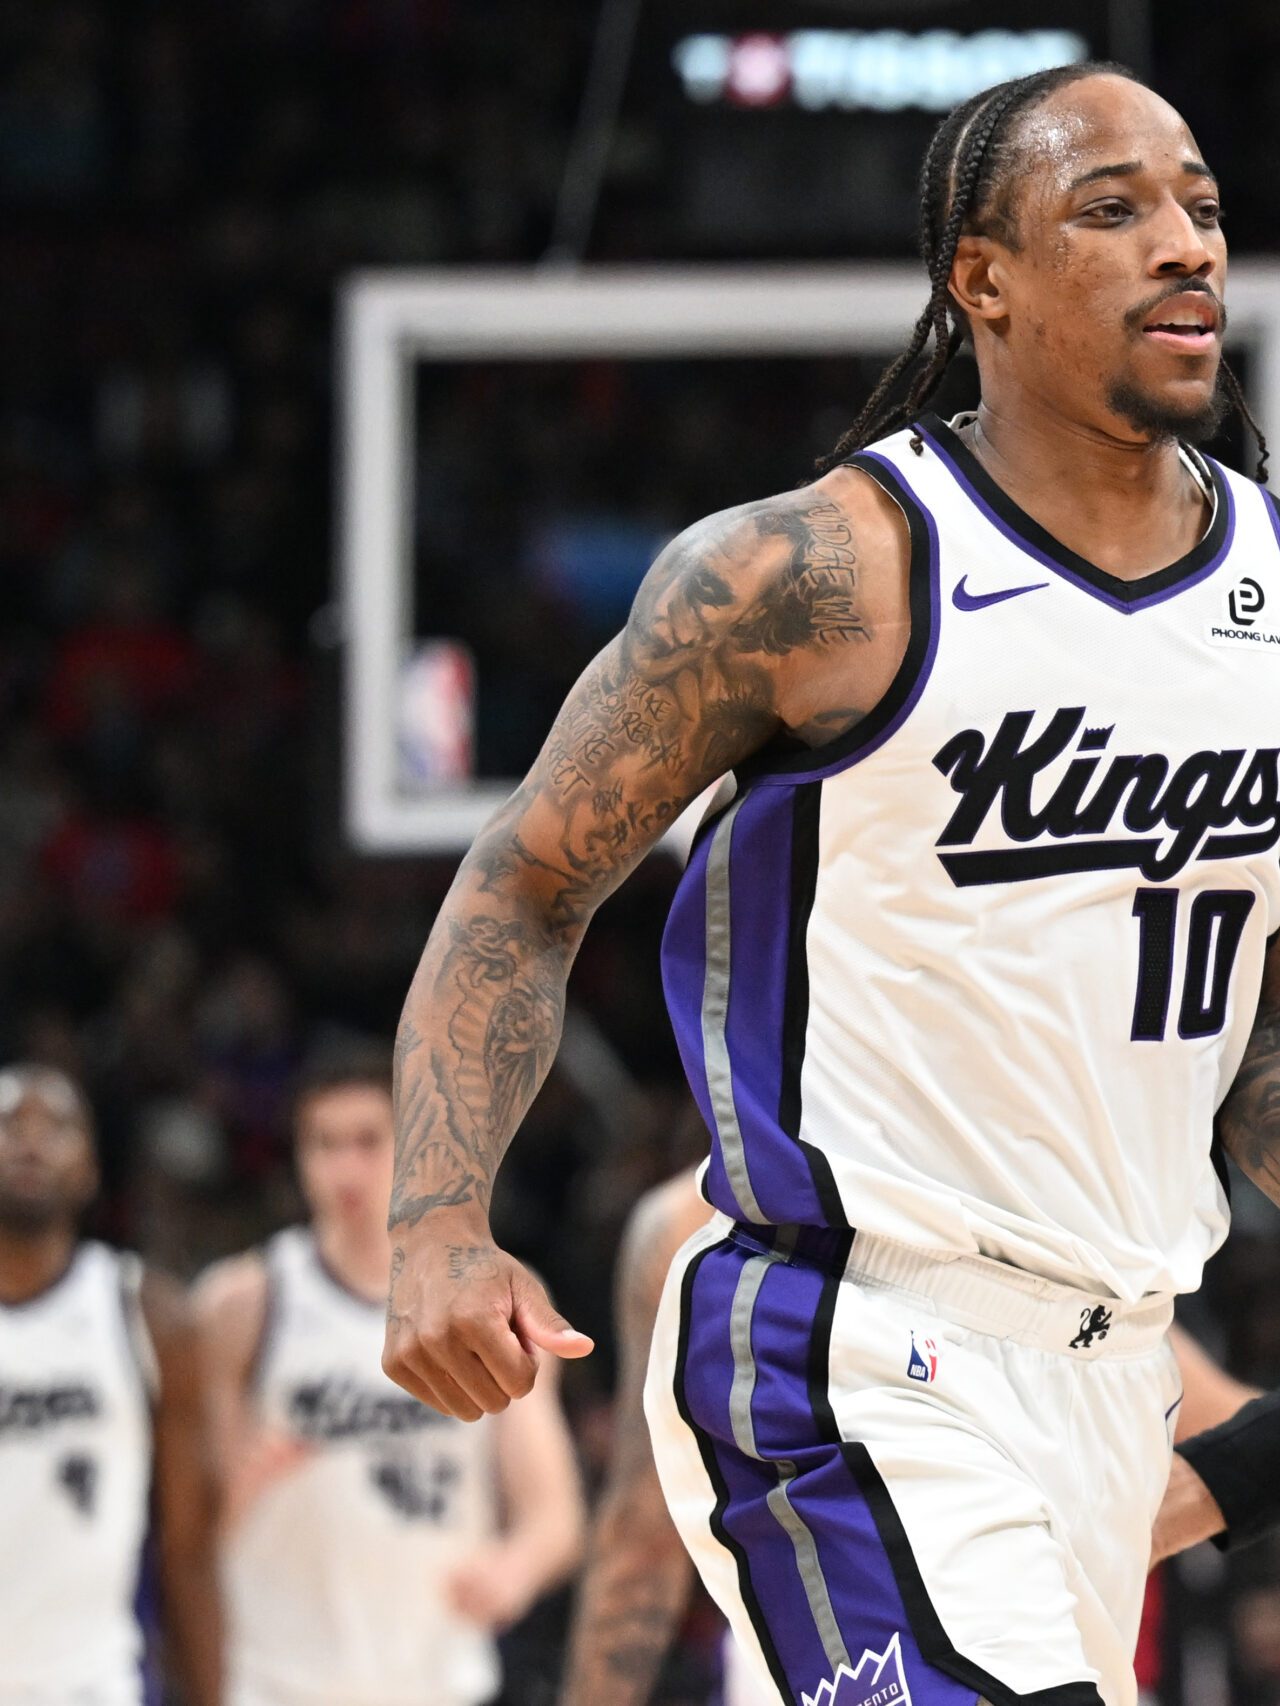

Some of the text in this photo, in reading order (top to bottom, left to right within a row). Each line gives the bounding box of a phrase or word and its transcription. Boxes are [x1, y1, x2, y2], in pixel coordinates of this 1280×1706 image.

[1211, 626, 1261, 642] PHOONG
[1130, 886, 1256, 1042] 10
[910, 1364, 926, 1379] NBA
